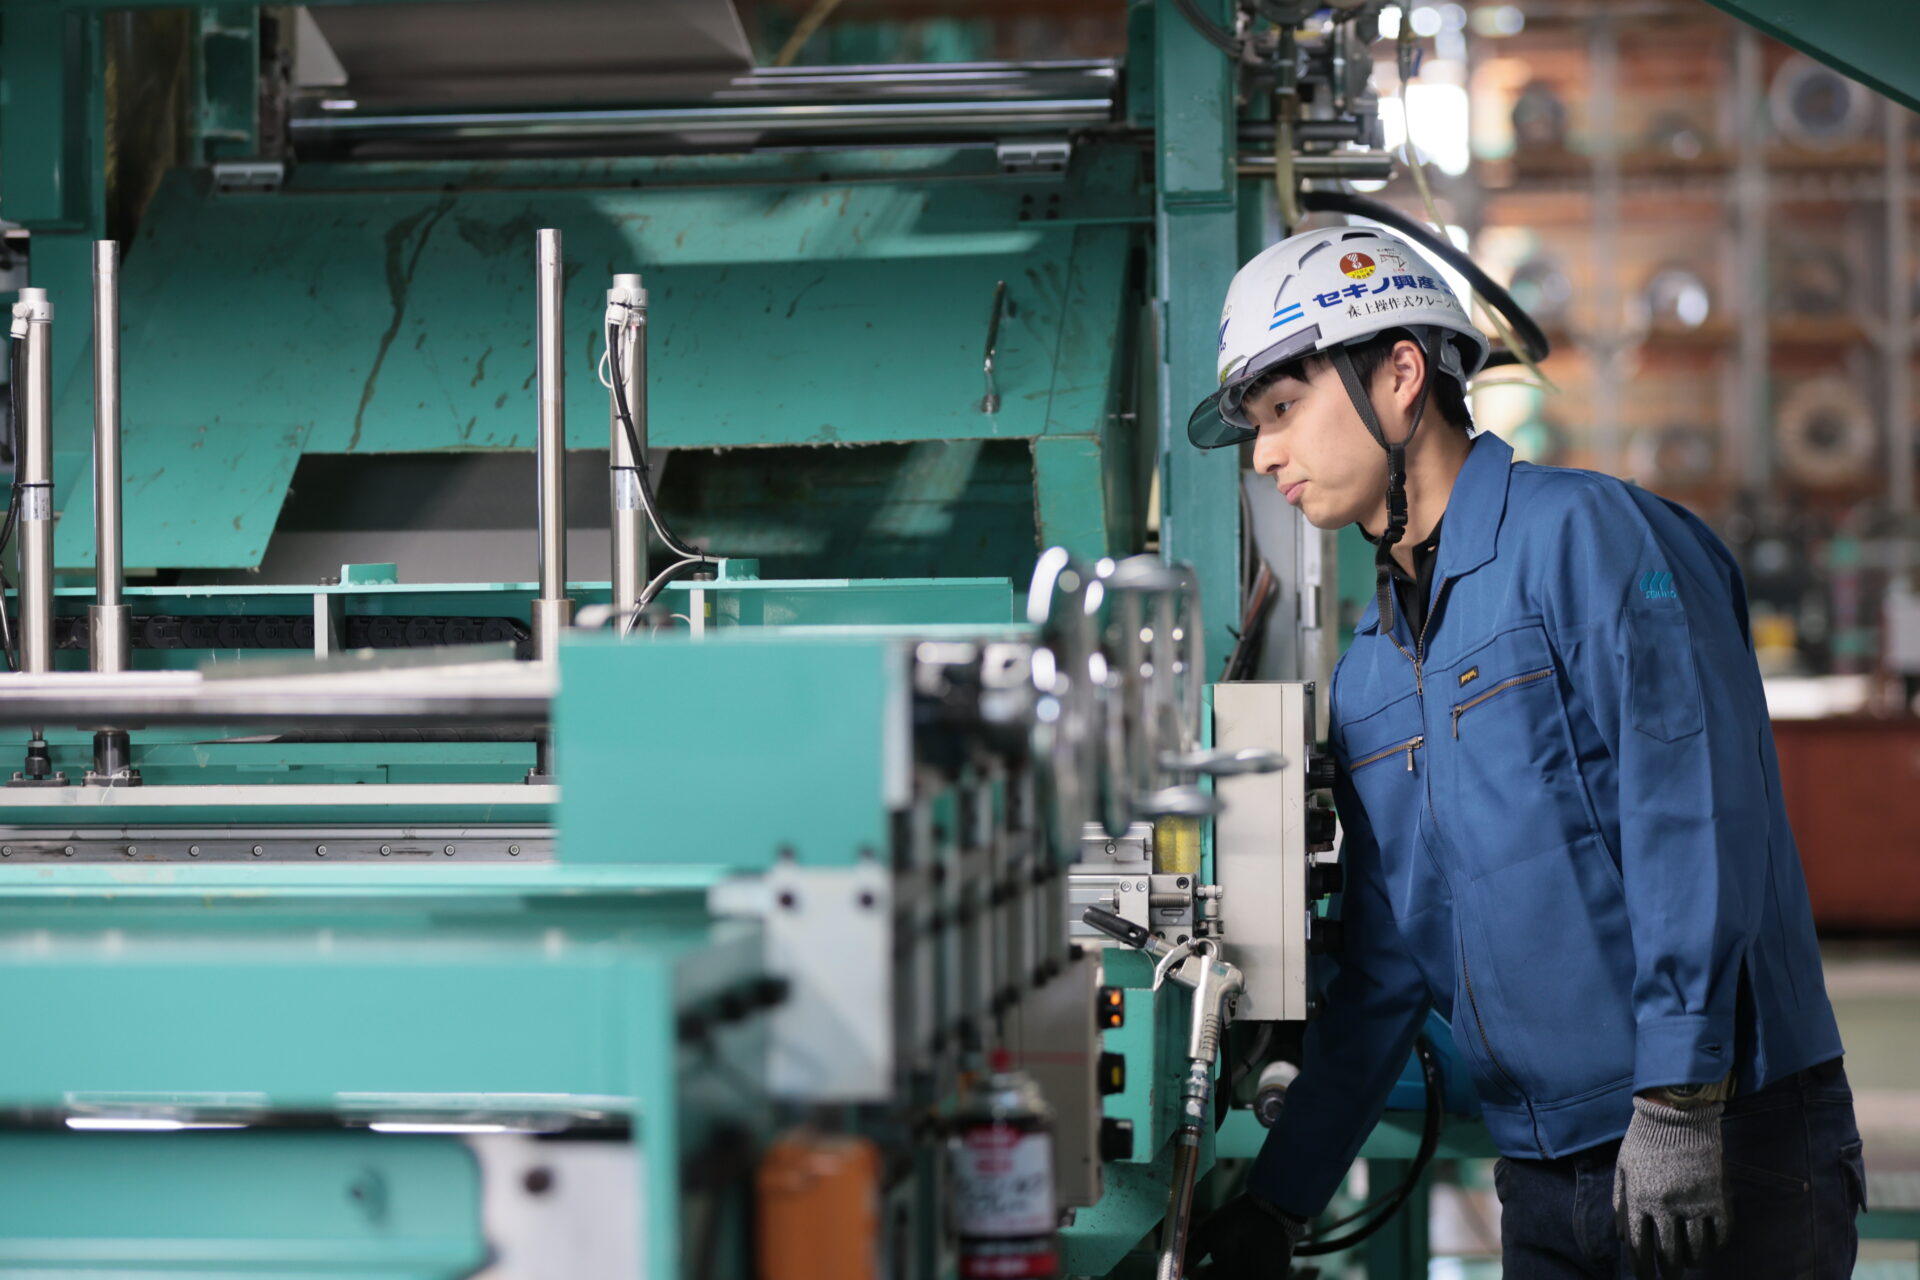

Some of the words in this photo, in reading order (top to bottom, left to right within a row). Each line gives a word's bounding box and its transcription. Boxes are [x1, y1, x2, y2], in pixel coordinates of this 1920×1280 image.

[1312, 275, 1439, 308] セキノ興産
